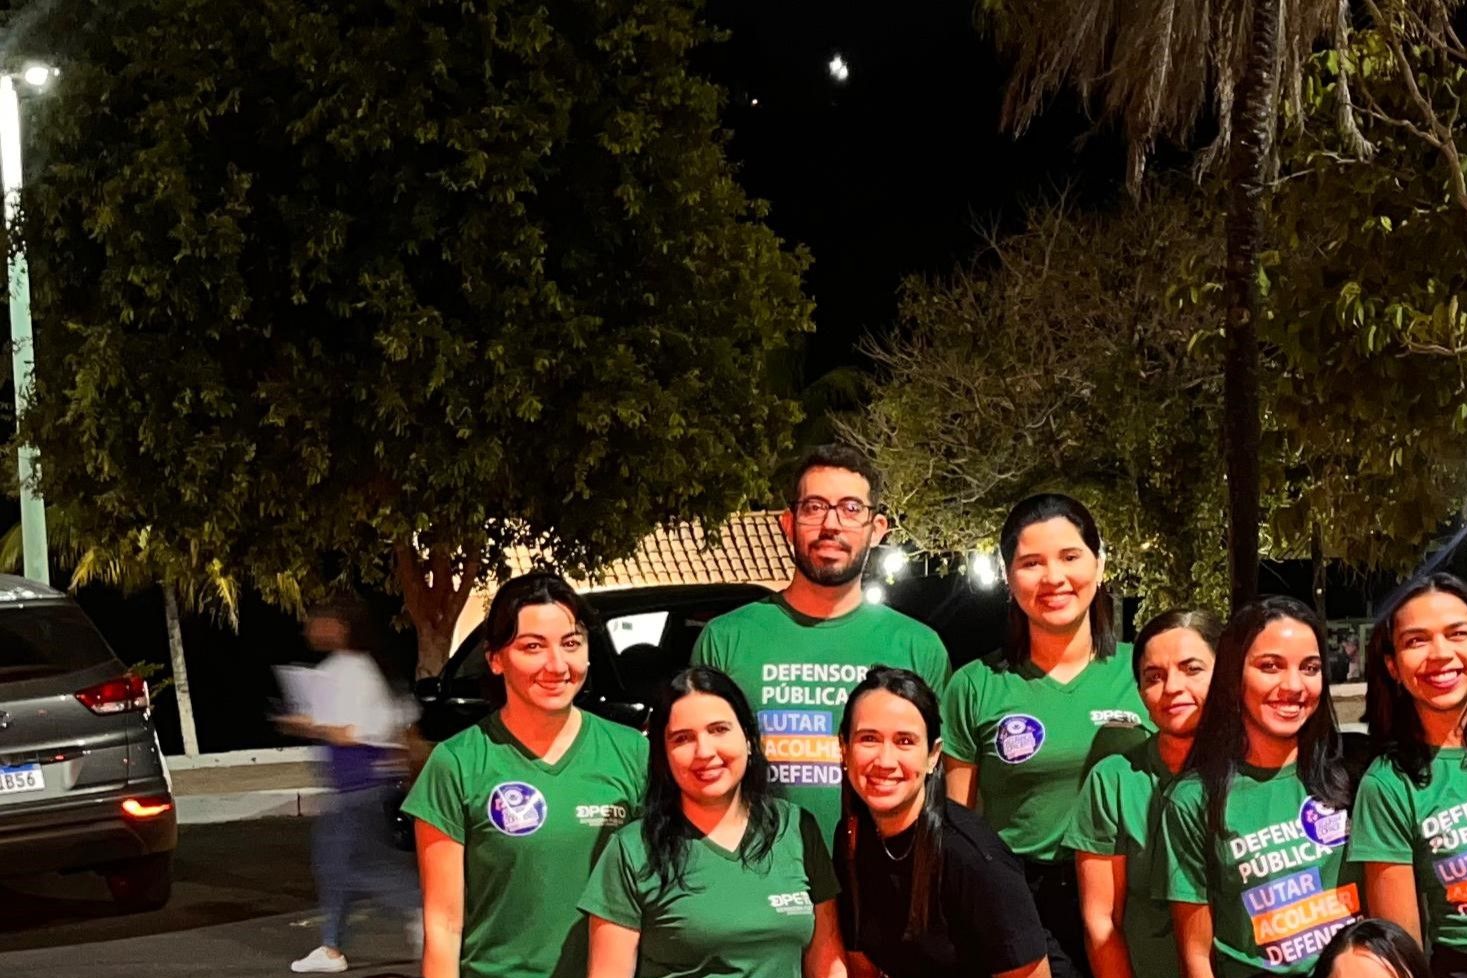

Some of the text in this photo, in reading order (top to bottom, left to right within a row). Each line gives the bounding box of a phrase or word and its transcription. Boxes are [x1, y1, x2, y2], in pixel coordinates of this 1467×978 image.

[762, 664, 868, 683] DEFENSOR
[762, 683, 849, 705] PÚBLICA
[763, 714, 826, 732] LUTAR
[765, 740, 842, 760] ACOLHE
[0, 772, 36, 790] B56
[767, 764, 842, 784] DEFEND
[1230, 819, 1306, 860] DEFENS
[1249, 873, 1316, 911] LUTAR
[1260, 890, 1355, 939] ACOLHER
[1266, 915, 1364, 966] DEFEN
